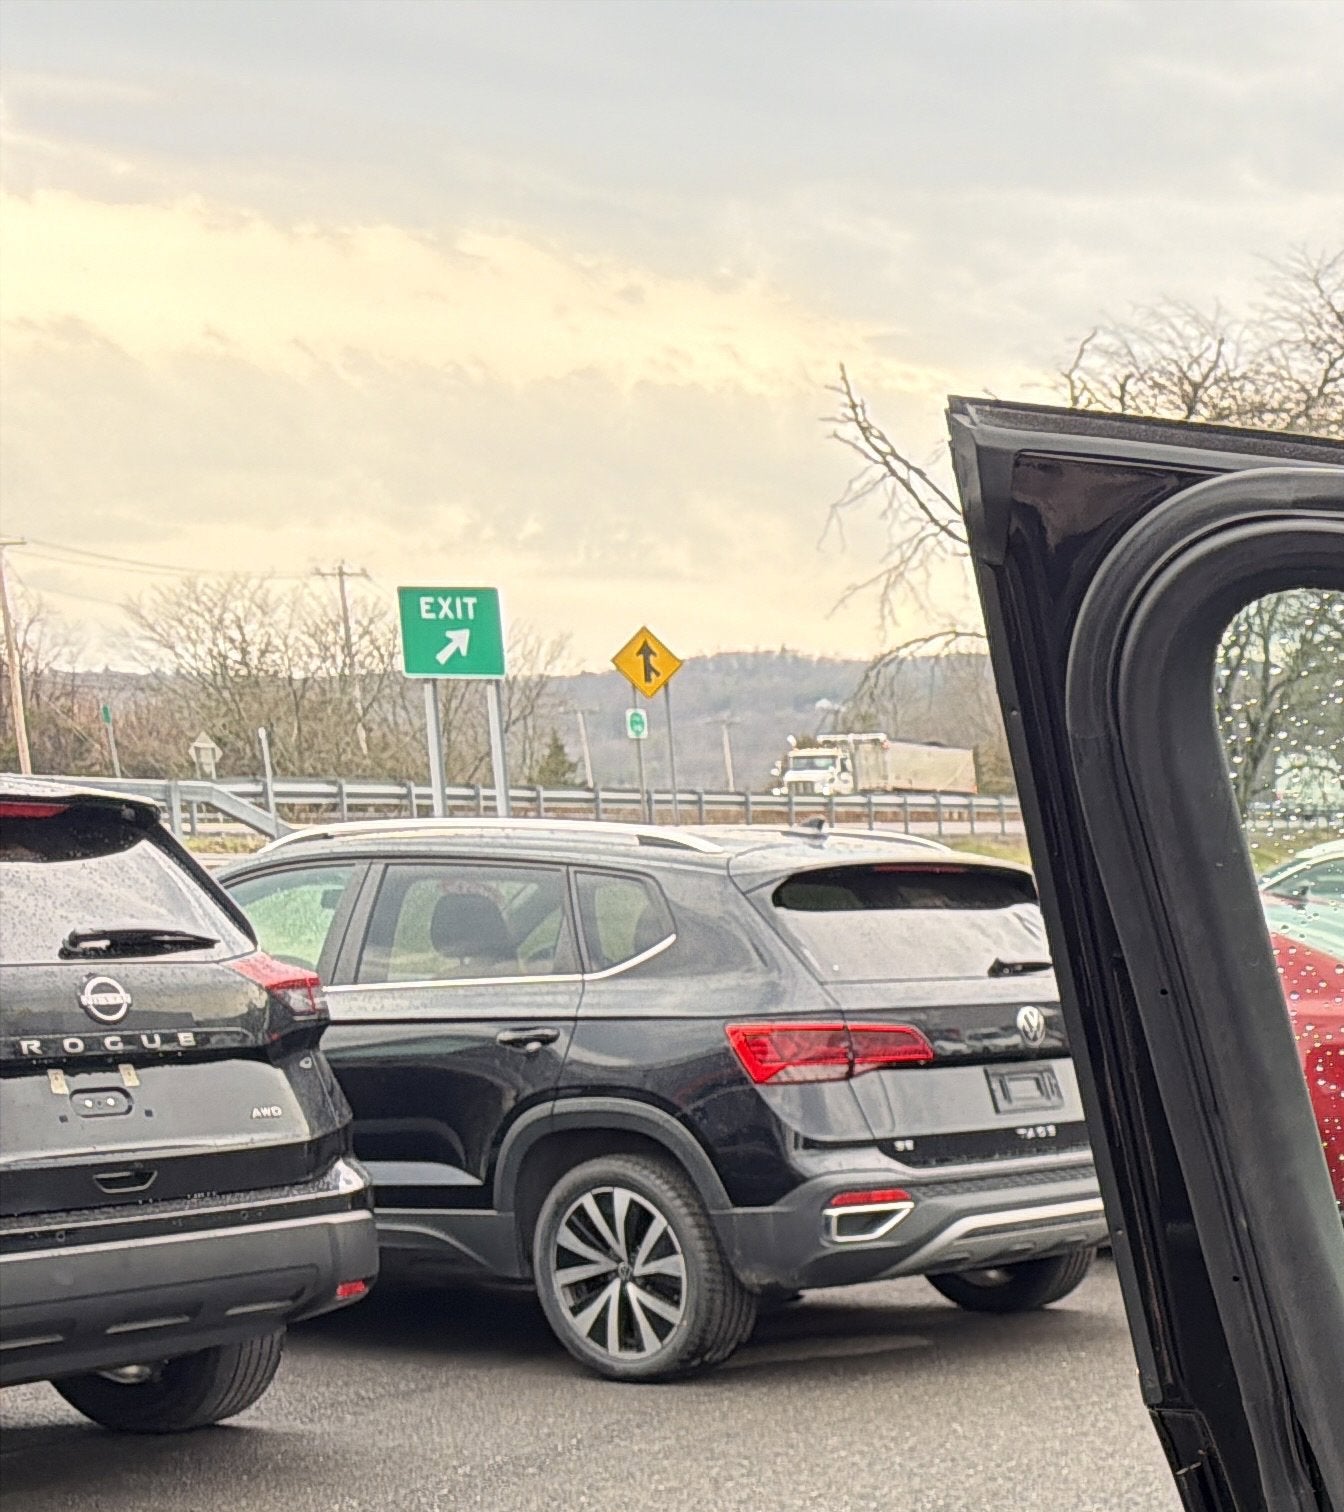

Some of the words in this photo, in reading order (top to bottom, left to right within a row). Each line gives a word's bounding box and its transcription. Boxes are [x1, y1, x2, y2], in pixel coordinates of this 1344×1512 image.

[420, 596, 477, 620] EXIT
[20, 1032, 196, 1055] ROGUE
[252, 1106, 282, 1118] AWD
